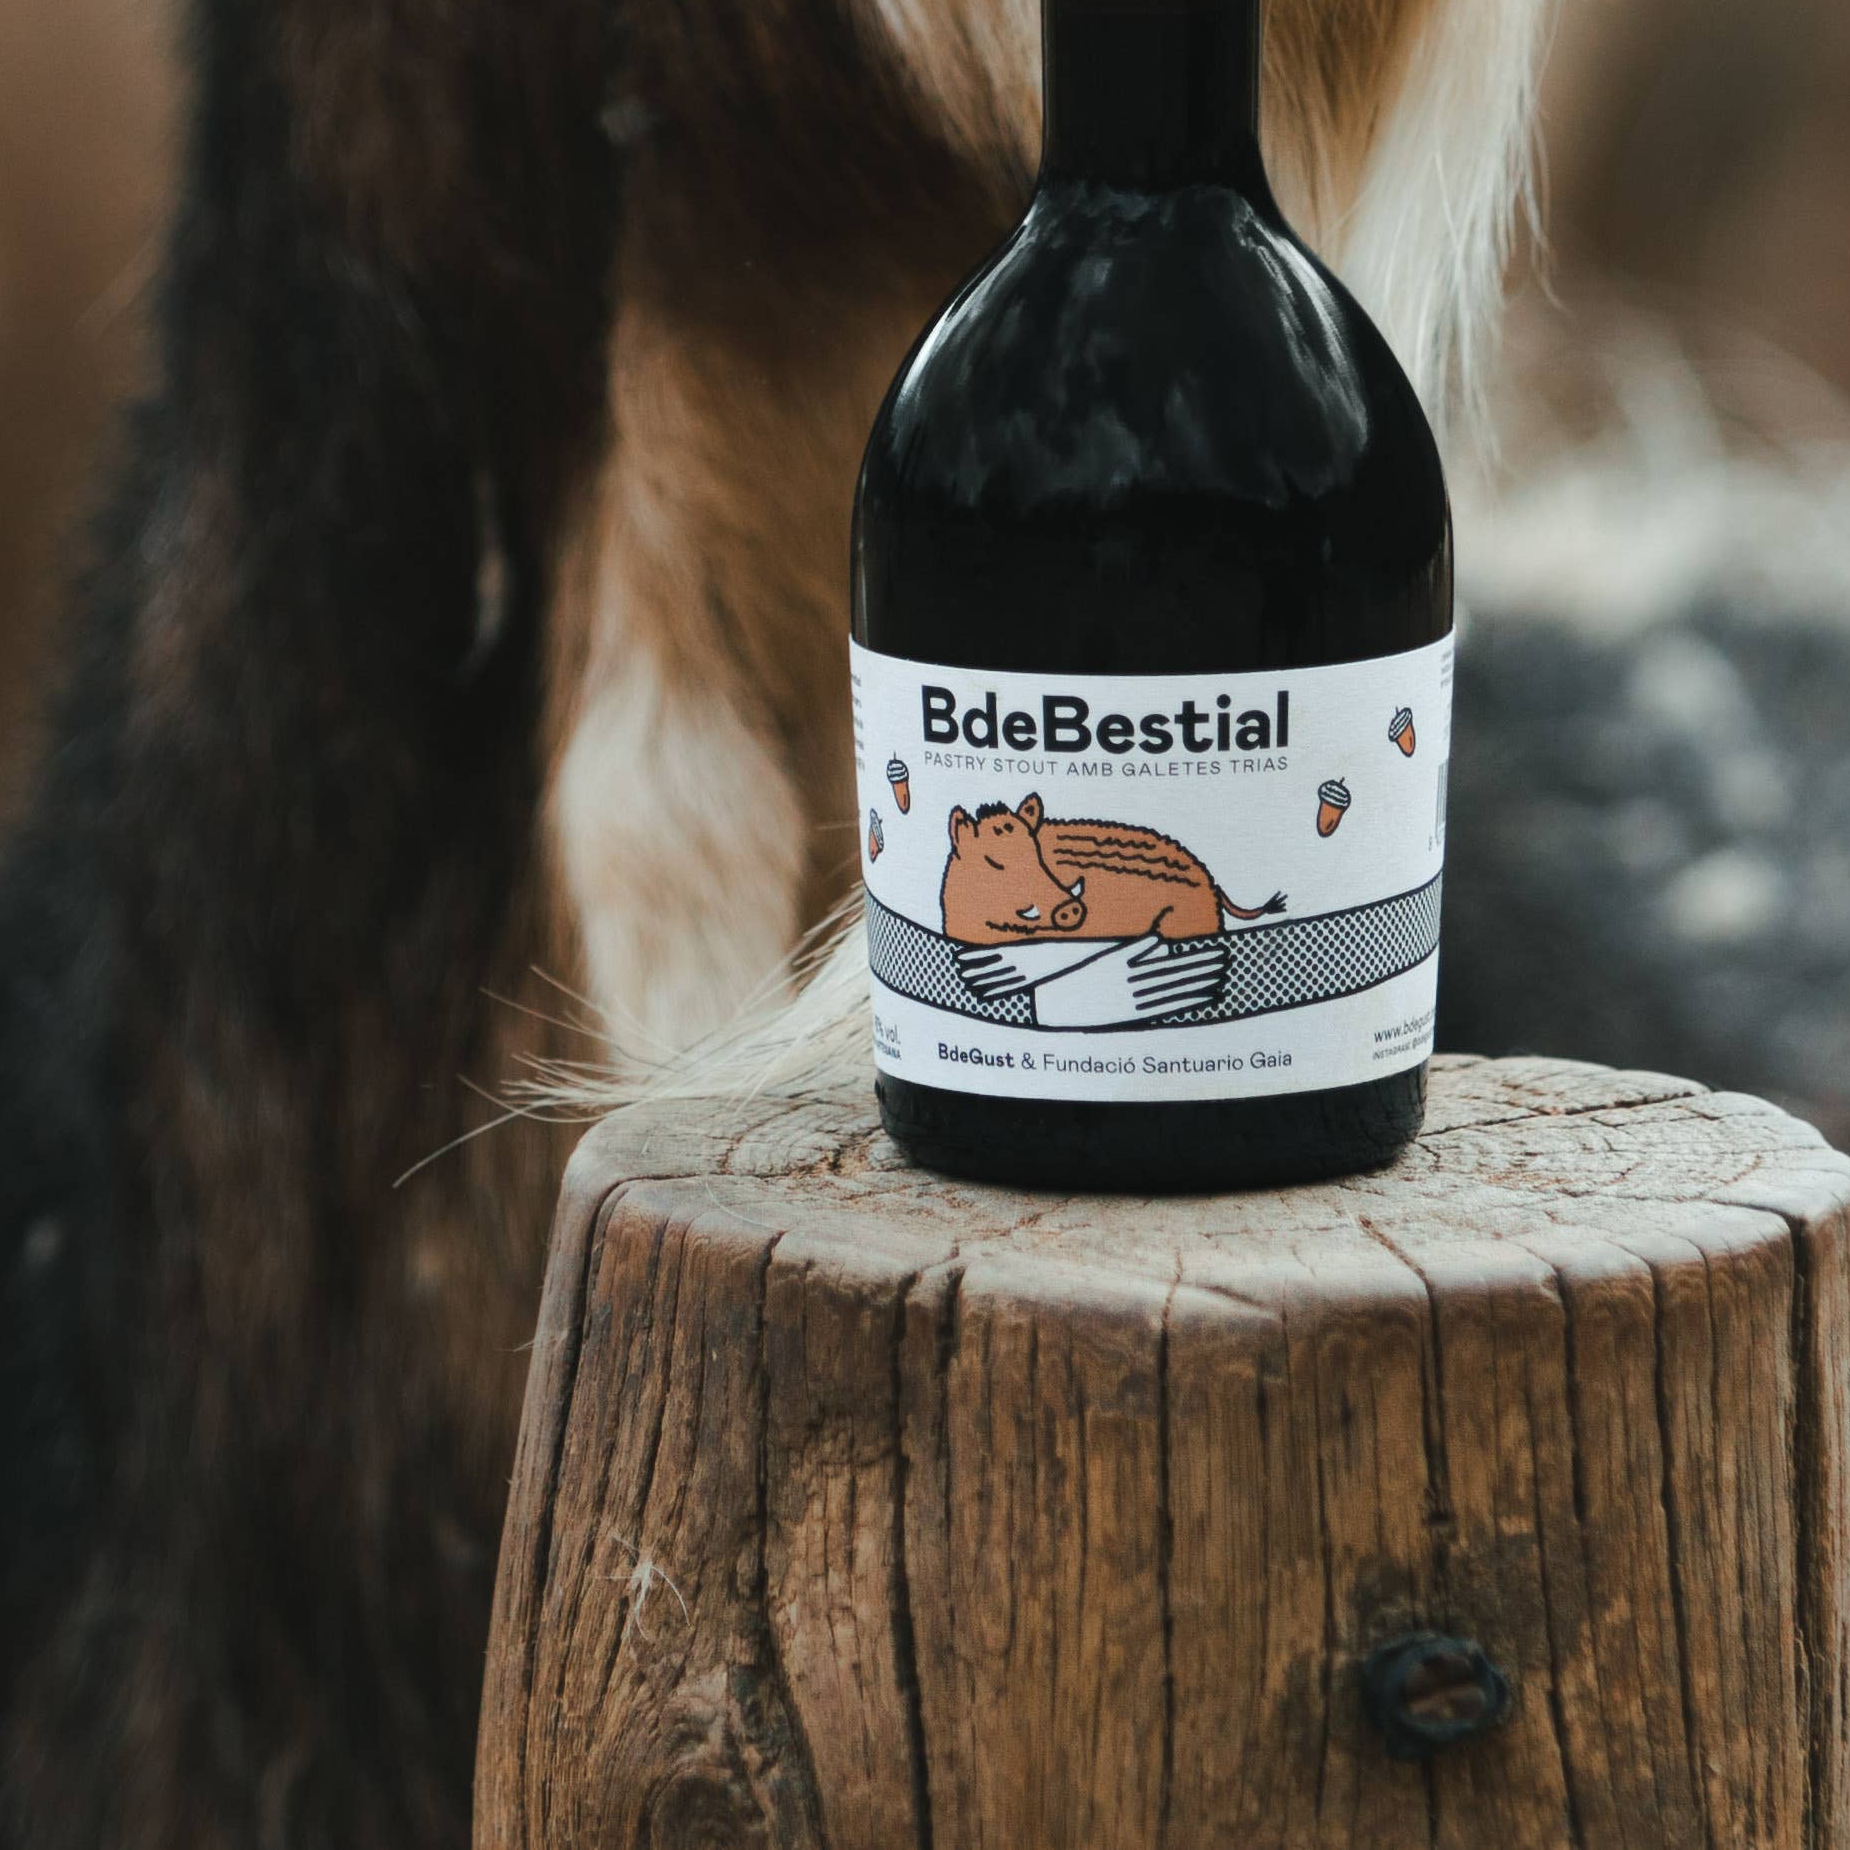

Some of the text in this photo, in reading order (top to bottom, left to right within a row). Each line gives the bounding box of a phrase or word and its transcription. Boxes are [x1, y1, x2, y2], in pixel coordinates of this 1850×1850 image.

[921, 684, 1290, 755] BdeBestial
[924, 750, 1289, 778] PASTRY STOUT AMB GALETES TRIAS
[937, 1042, 1293, 1075] BdeGust & Fundació Santuario Gaia
